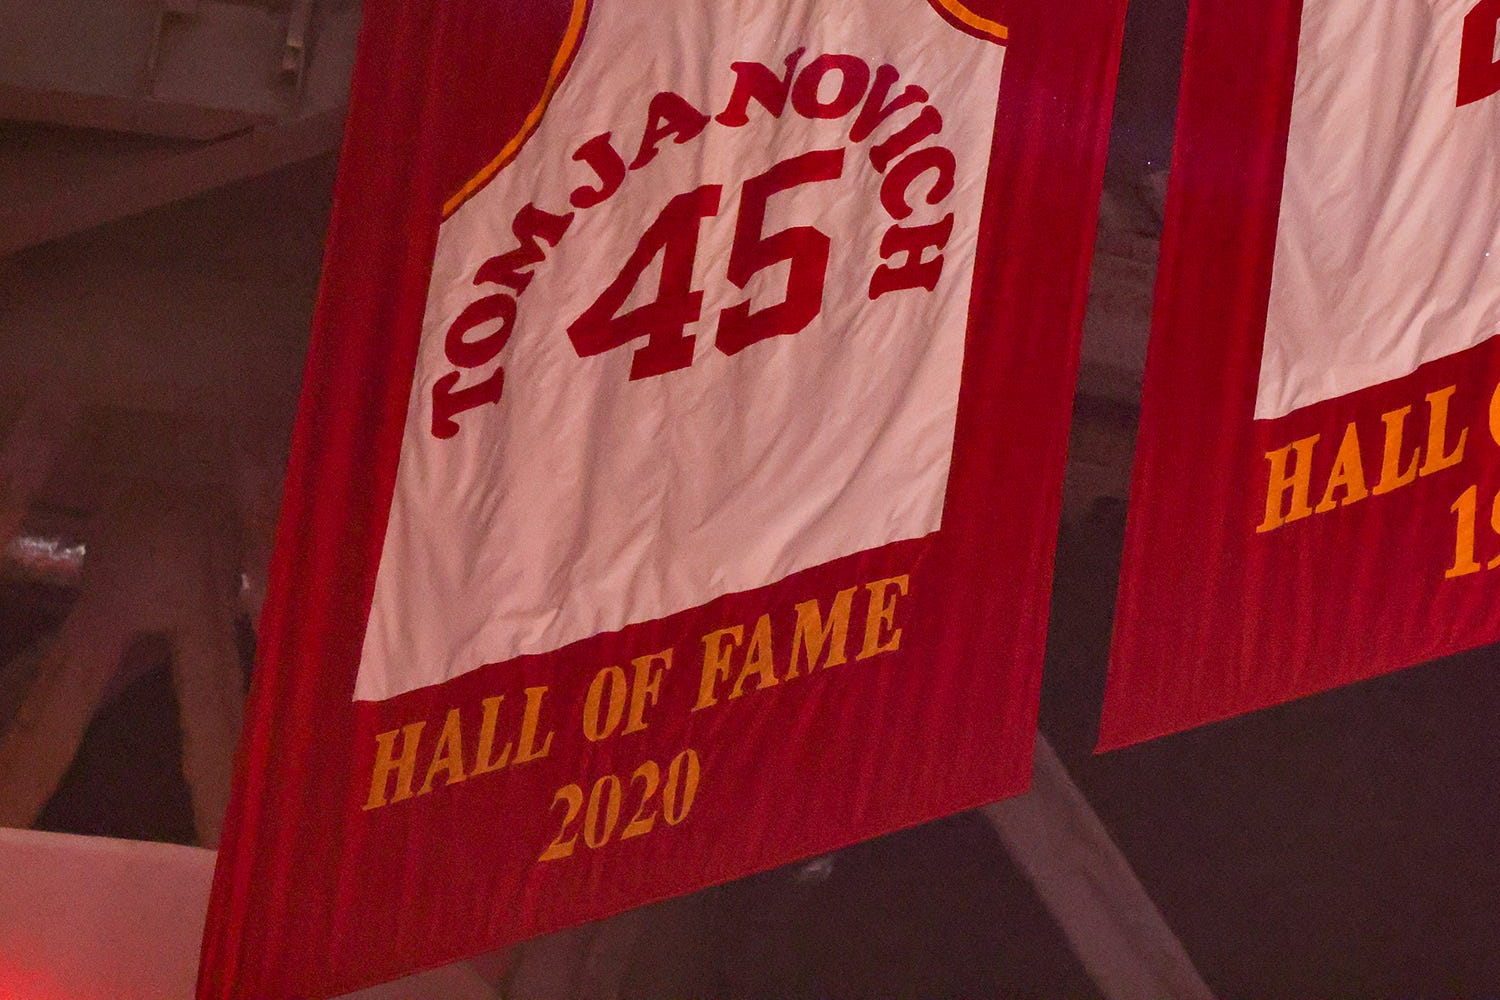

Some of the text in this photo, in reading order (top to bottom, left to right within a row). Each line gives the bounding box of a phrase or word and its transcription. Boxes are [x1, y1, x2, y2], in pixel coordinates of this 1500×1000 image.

[431, 46, 958, 440] TOMJANOVICH
[566, 147, 846, 382] 45
[1256, 384, 1469, 534] HALL
[361, 574, 910, 811] HALL OF FAME
[538, 748, 701, 862] 2020
